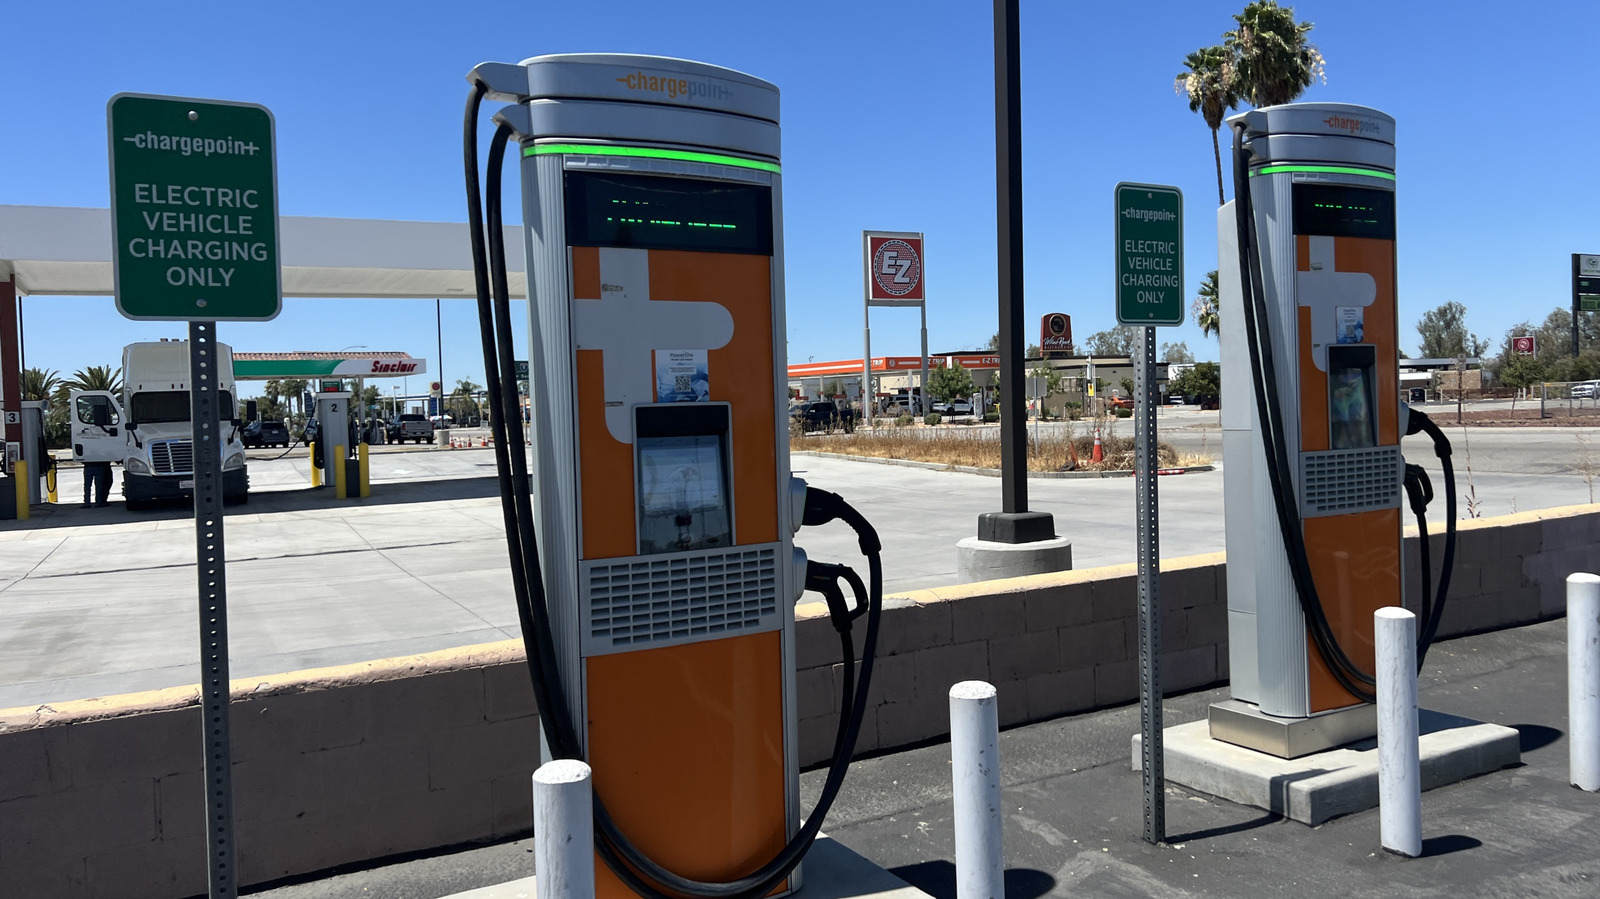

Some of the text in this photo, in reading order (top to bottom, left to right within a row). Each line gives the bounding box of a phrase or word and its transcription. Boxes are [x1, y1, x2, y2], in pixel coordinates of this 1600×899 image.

[134, 183, 259, 209] ELECTRIC
[142, 211, 253, 235] VEHICLE
[128, 237, 268, 262] CHARGING
[1125, 239, 1175, 255] ELECTRIC
[1127, 256, 1173, 271] VEHICLE
[166, 266, 236, 288] ONLY
[1122, 273, 1179, 288] CHARGING
[1136, 290, 1165, 304] ONLY
[371, 360, 418, 373] Sinclair
[331, 403, 338, 412] 2
[8, 412, 16, 423] 3
